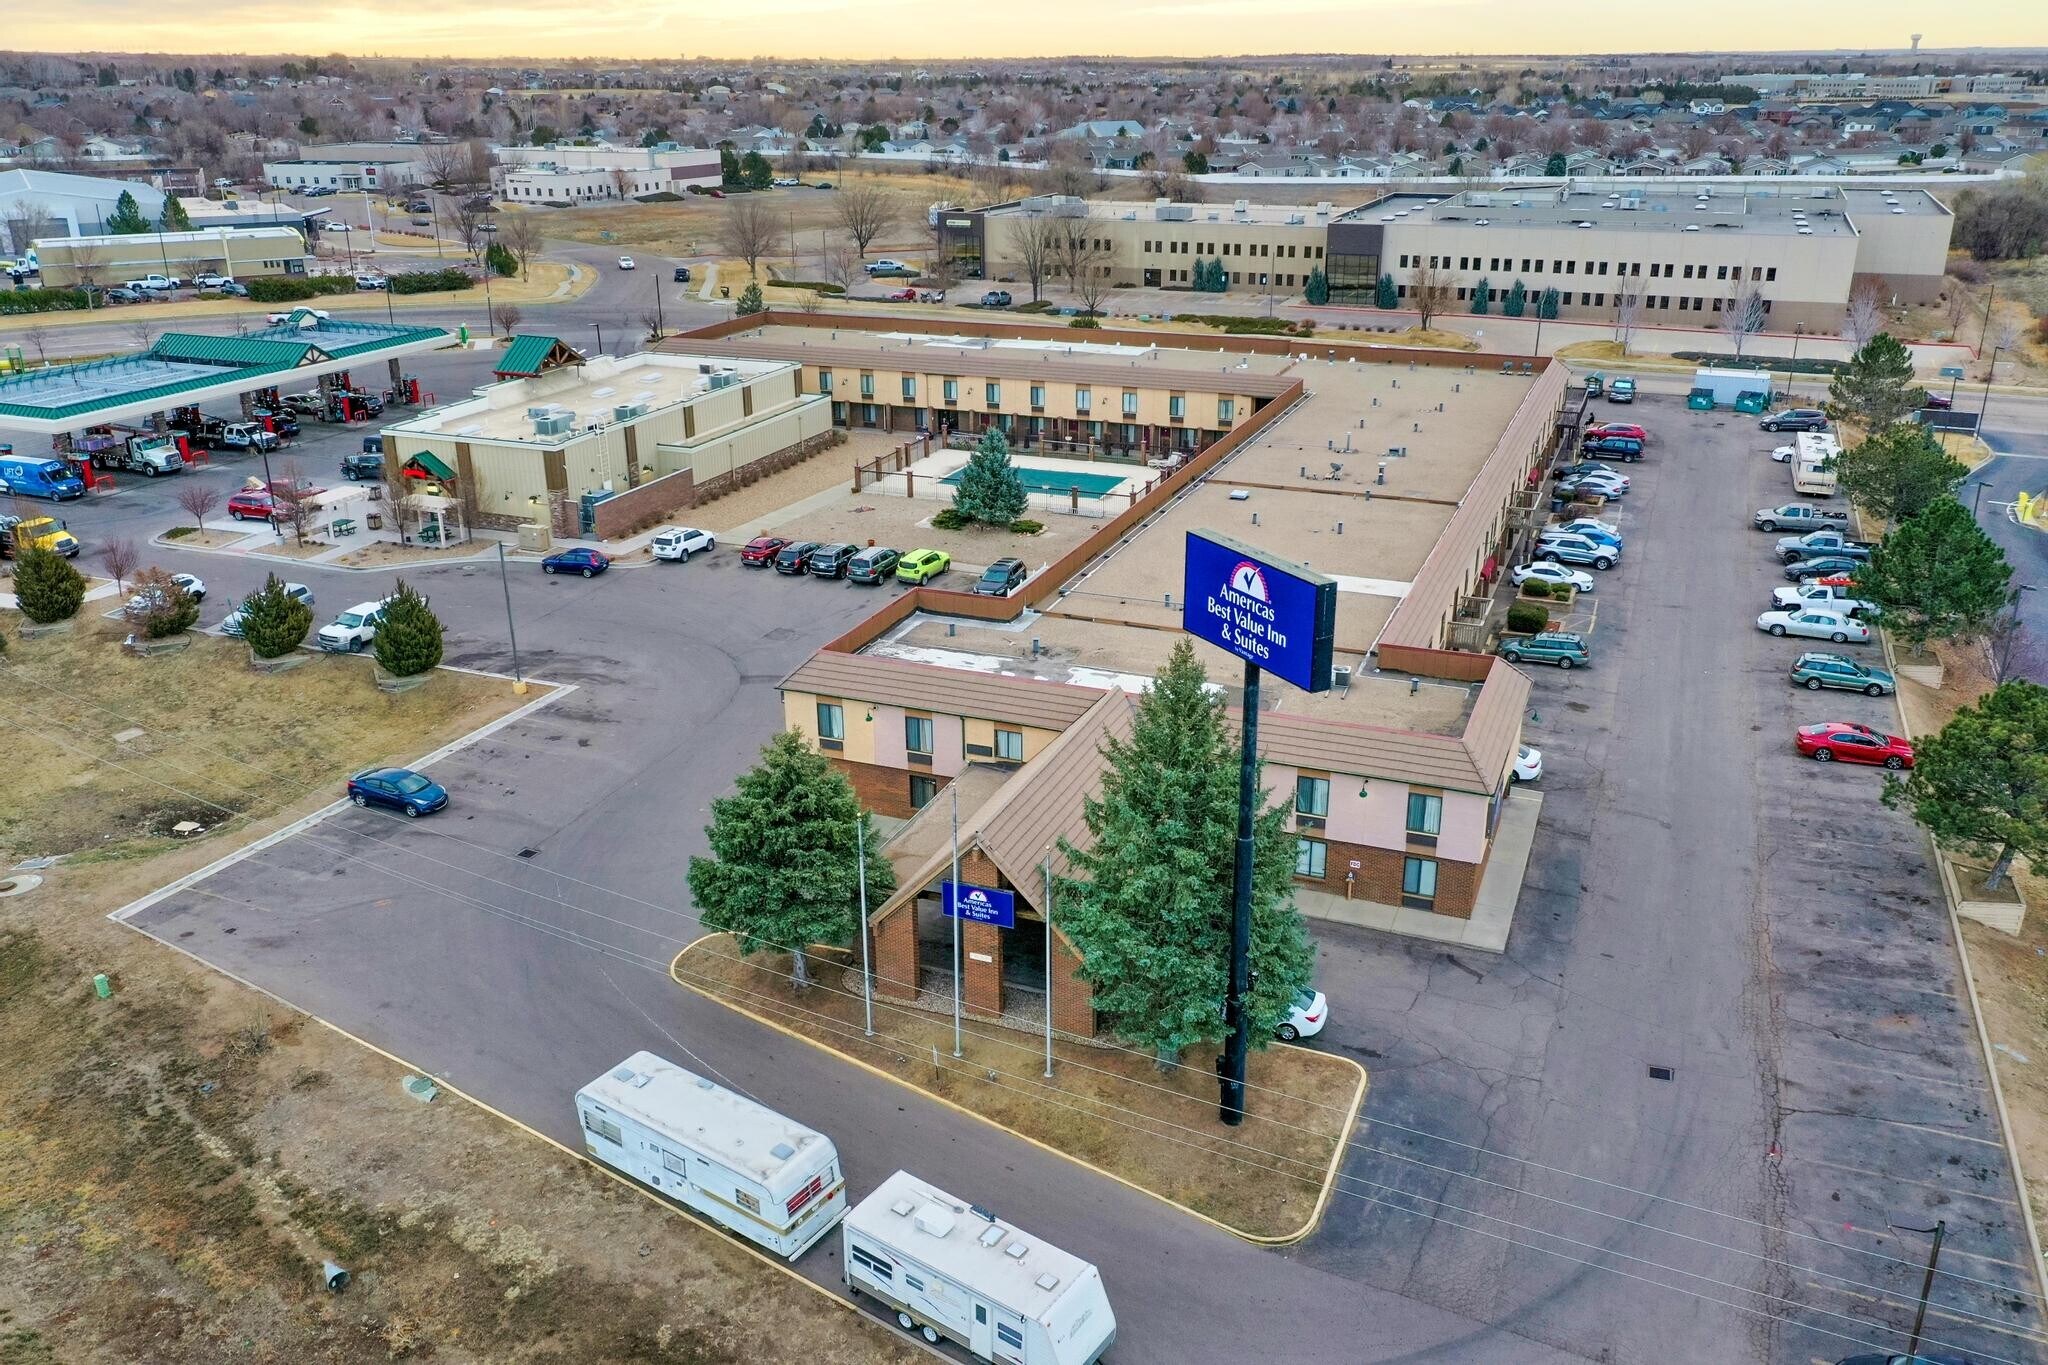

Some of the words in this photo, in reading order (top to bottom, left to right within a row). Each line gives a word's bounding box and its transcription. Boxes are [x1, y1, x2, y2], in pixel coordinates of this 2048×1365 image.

[1220, 583, 1275, 622] Americas
[1208, 596, 1231, 622] Best
[1234, 607, 1265, 637] Value
[1267, 624, 1287, 649] Inn
[1221, 623, 1232, 641] &
[1234, 628, 1270, 660] Suites
[957, 902, 970, 910] Best
[971, 904, 987, 914] Value
[988, 907, 999, 916] Inn
[963, 897, 992, 908] Americas
[972, 910, 991, 920] Suites
